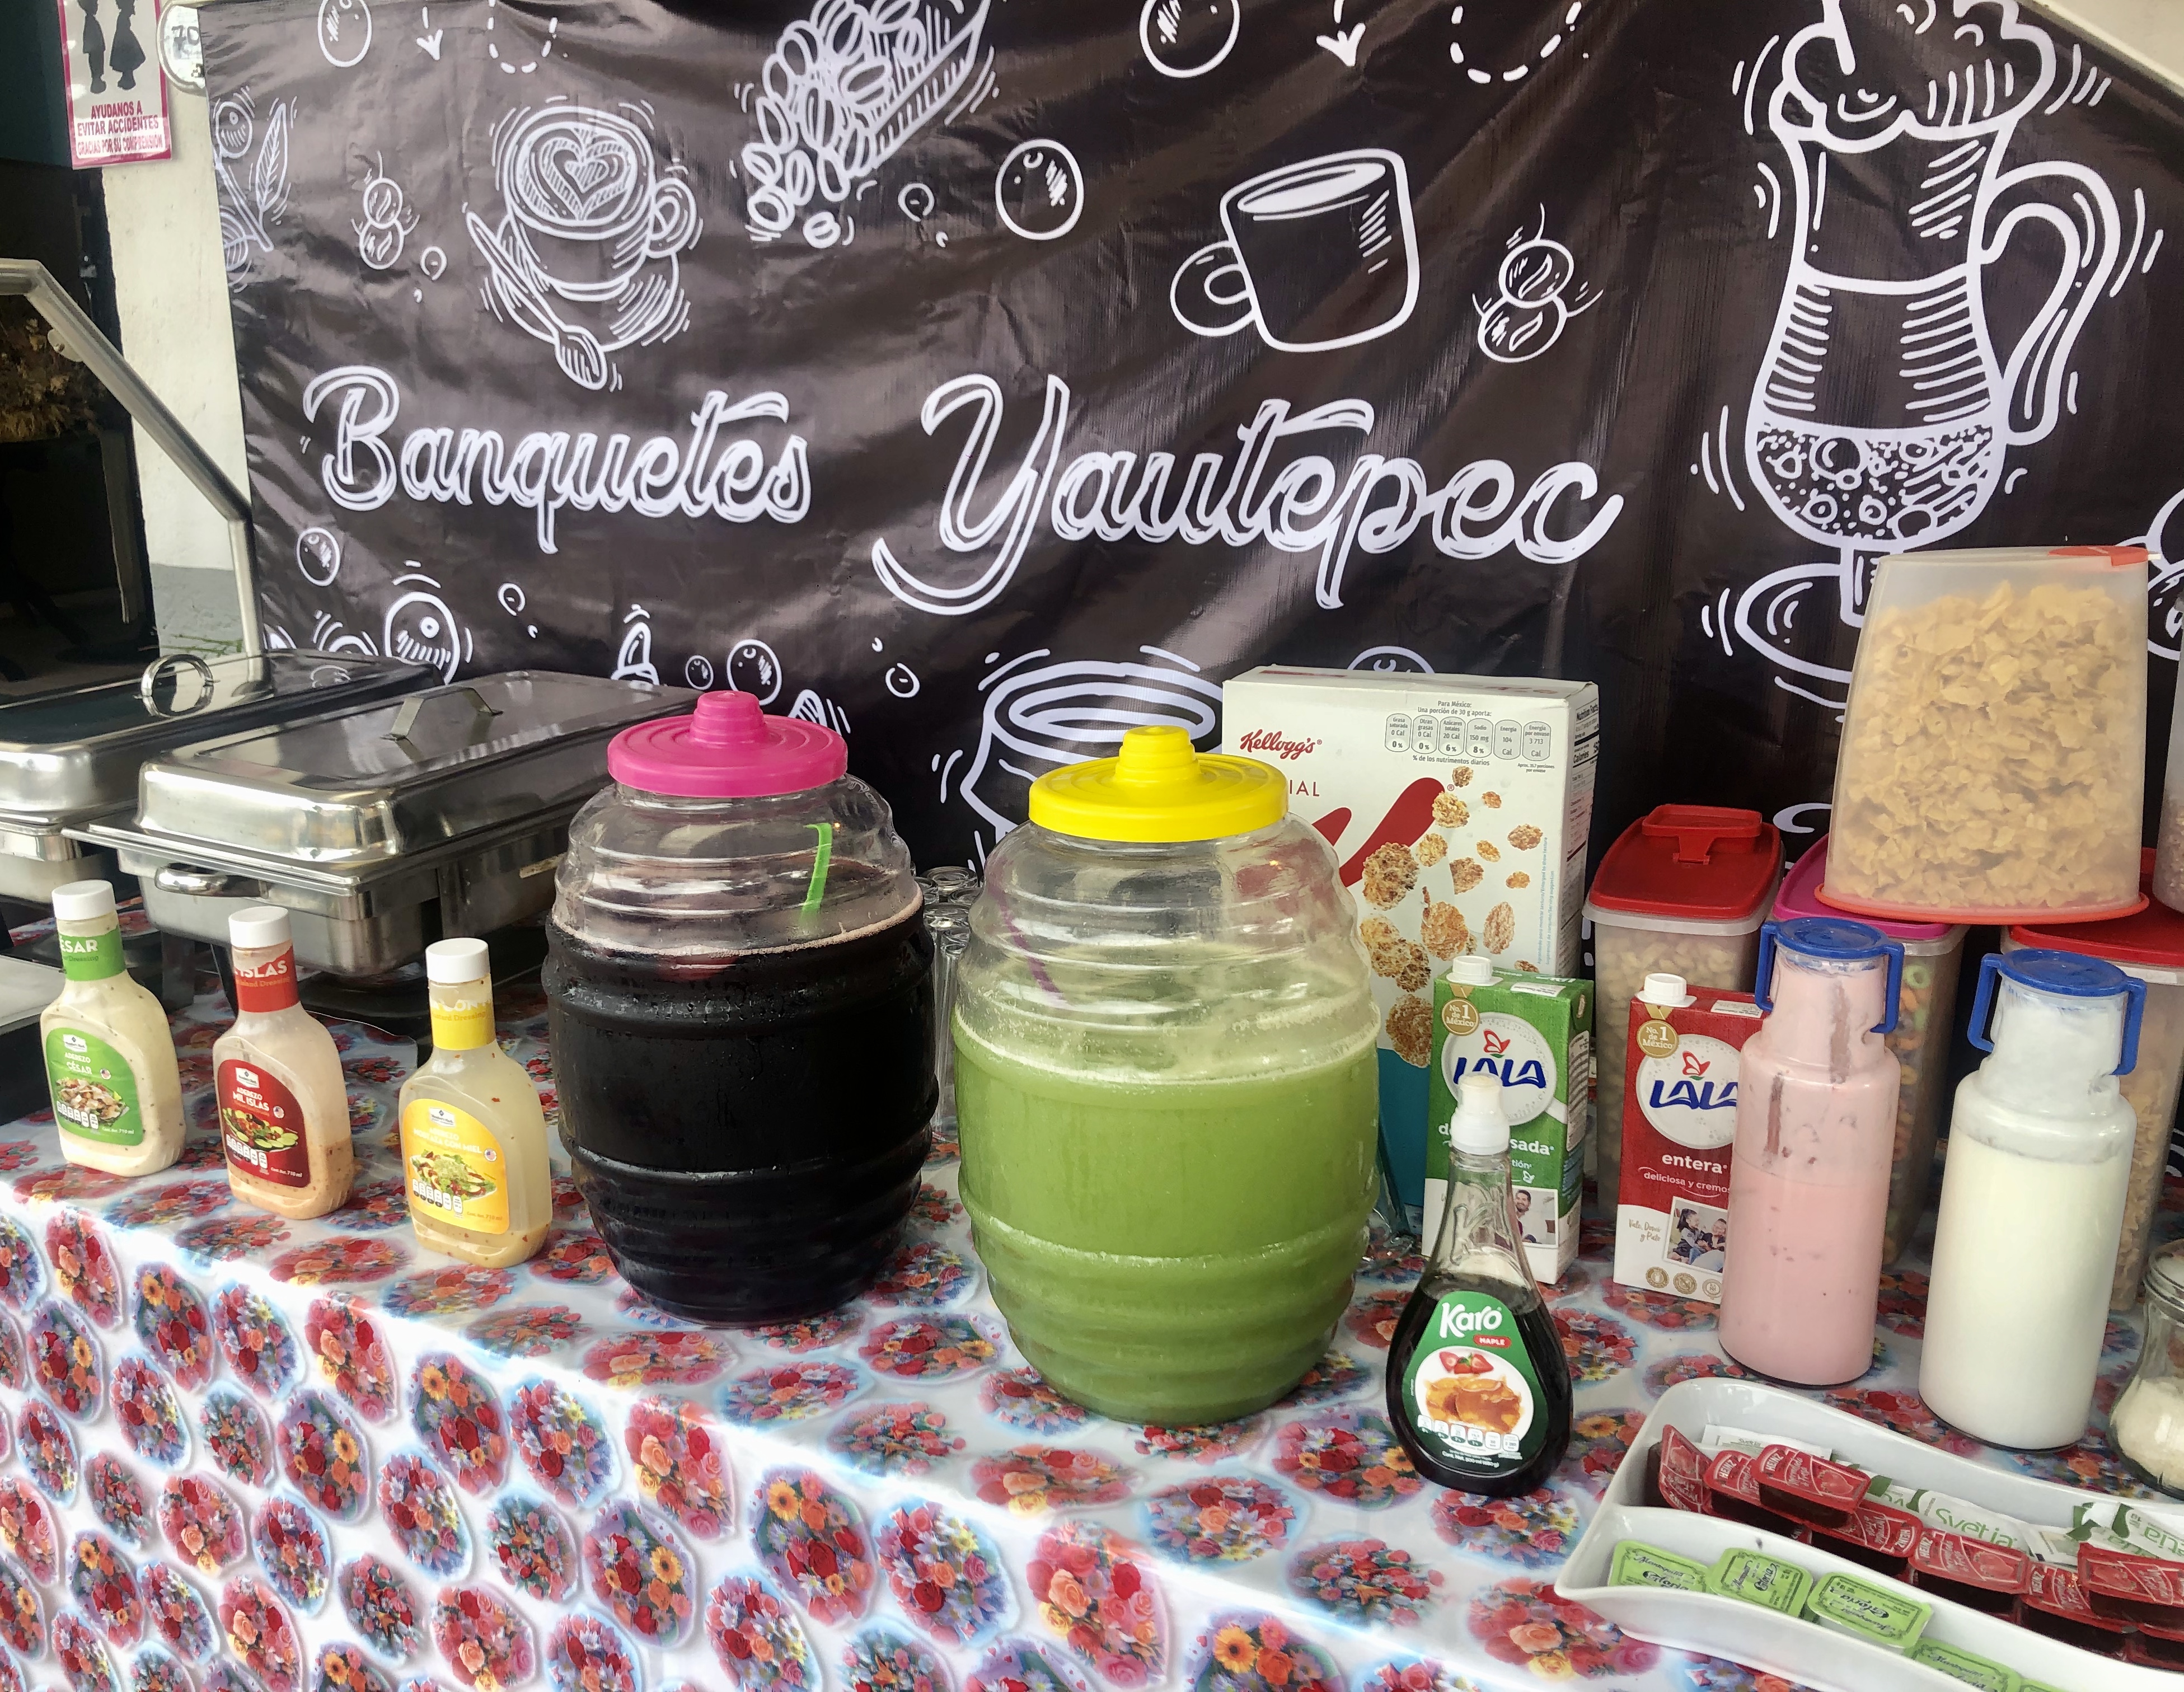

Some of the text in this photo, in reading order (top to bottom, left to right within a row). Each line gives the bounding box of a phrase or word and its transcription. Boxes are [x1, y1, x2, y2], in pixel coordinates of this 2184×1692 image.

[91, 100, 143, 119] AYUDANOS A
[77, 115, 159, 137] EVITAR ACCIDENTES
[77, 140, 101, 156] GRACIAS
[101, 138, 113, 153] POR
[114, 137, 121, 153] SU
[303, 365, 1624, 615] Banquetes Yautepec
[1240, 729, 1316, 760] Kellogg's
[59, 936, 99, 953] ÉSAR
[1451, 1011, 1460, 1019] de
[1461, 1004, 1471, 1019] 1
[1446, 1016, 1475, 1028] México
[1660, 1026, 1669, 1041] 1
[1642, 1038, 1673, 1049] México
[66, 1061, 92, 1075] CÉSAR
[246, 1096, 270, 1112] ISLAS
[462, 1143, 482, 1154] MIEL
[1661, 1154, 1723, 1174] entera
[1643, 1171, 1686, 1186] deliciosa
[1439, 1302, 1503, 1339] Karo
[1479, 1337, 1505, 1346] MAPLE
[1719, 1459, 1737, 1479] HEINZ
[1765, 1453, 1784, 1471] HEINZ
[1894, 1529, 1911, 1548] HEINZ
[1919, 1537, 1933, 1559] HEINZ
[1754, 1566, 1775, 1591] Gloria
[2031, 1571, 2045, 1593] HEINZ
[1840, 1595, 1890, 1619] Gloria
